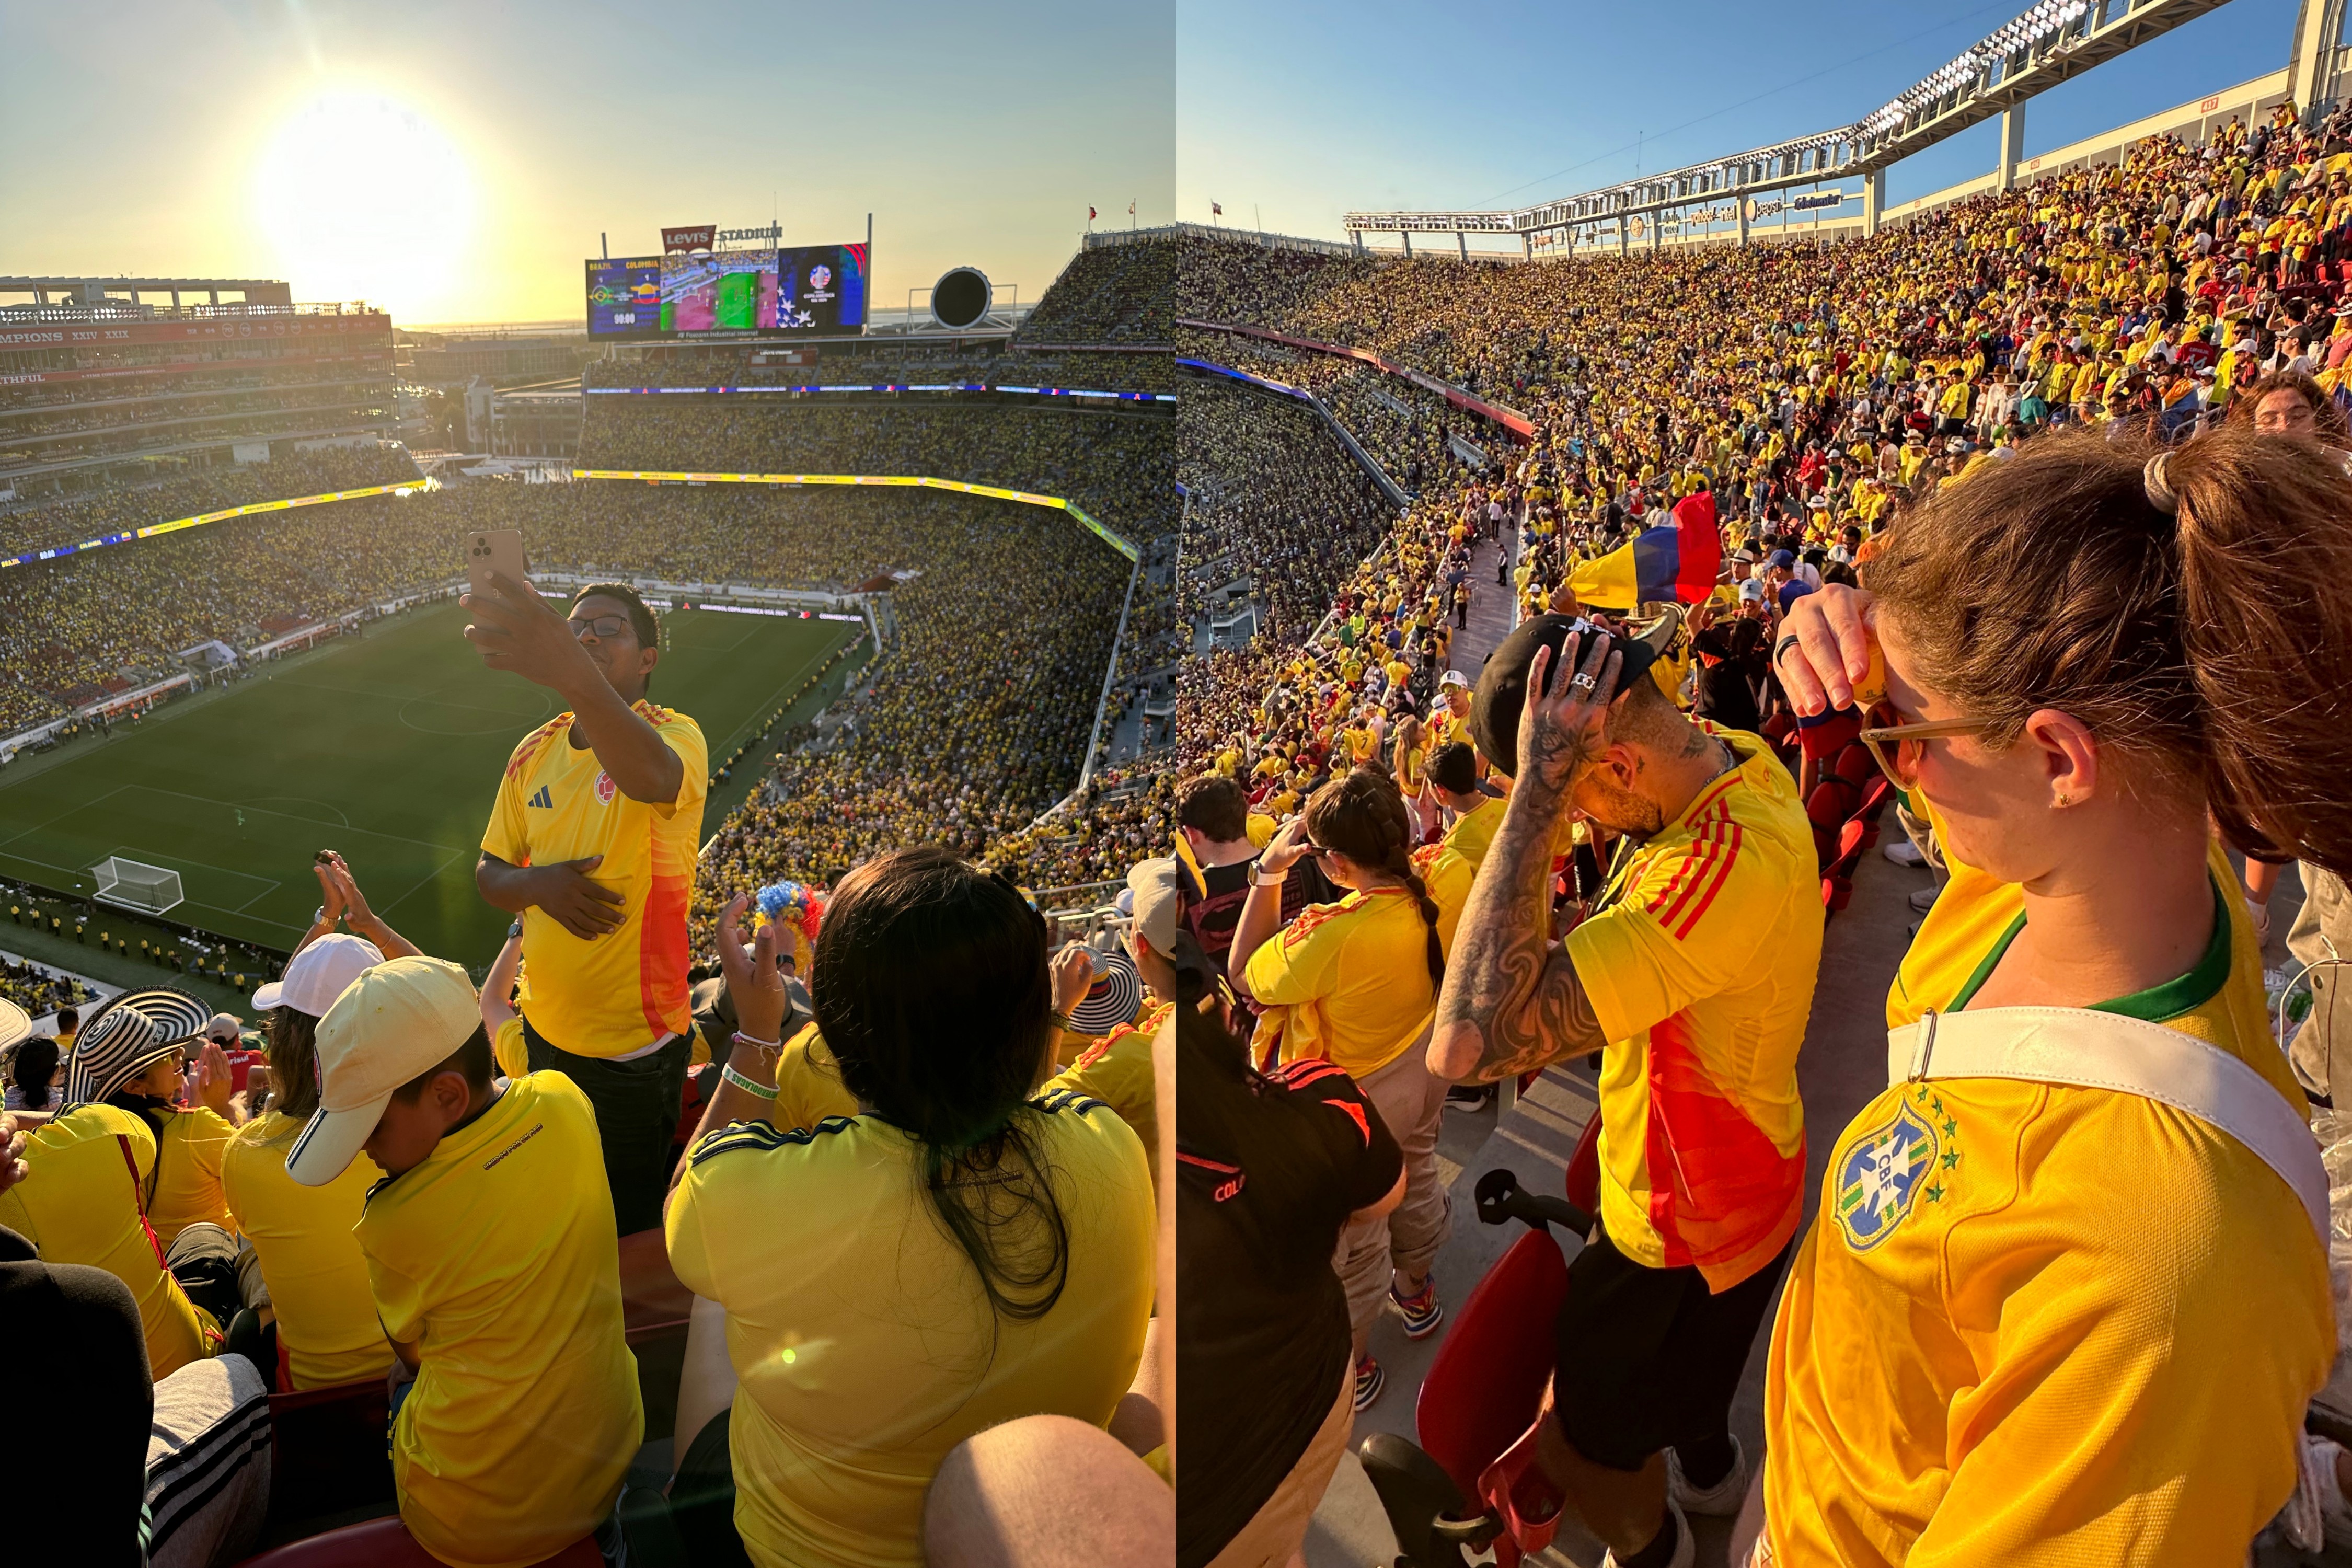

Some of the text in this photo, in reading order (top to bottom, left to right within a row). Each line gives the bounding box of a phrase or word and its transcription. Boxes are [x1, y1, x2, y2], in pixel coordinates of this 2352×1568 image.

[2202, 99, 2217, 110] 417
[1720, 204, 1737, 222] intel
[1757, 197, 1781, 218] pepsi
[1691, 205, 1716, 227] yahoo!
[719, 226, 783, 241] STADIUM
[626, 260, 659, 269] COLOMBIA
[614, 313, 636, 324] 90:00
[72, 331, 97, 340] XXIV
[105, 330, 129, 339] XXIX
[0, 374, 45, 385] THFUL
[1361, 737, 1368, 750] 7
[229, 1054, 249, 1065] risul
[483, 1149, 509, 1170] UNIDOS
[507, 1139, 522, 1153] POR
[520, 1133, 531, 1143] UN
[1878, 1154, 1891, 1191] CBF
